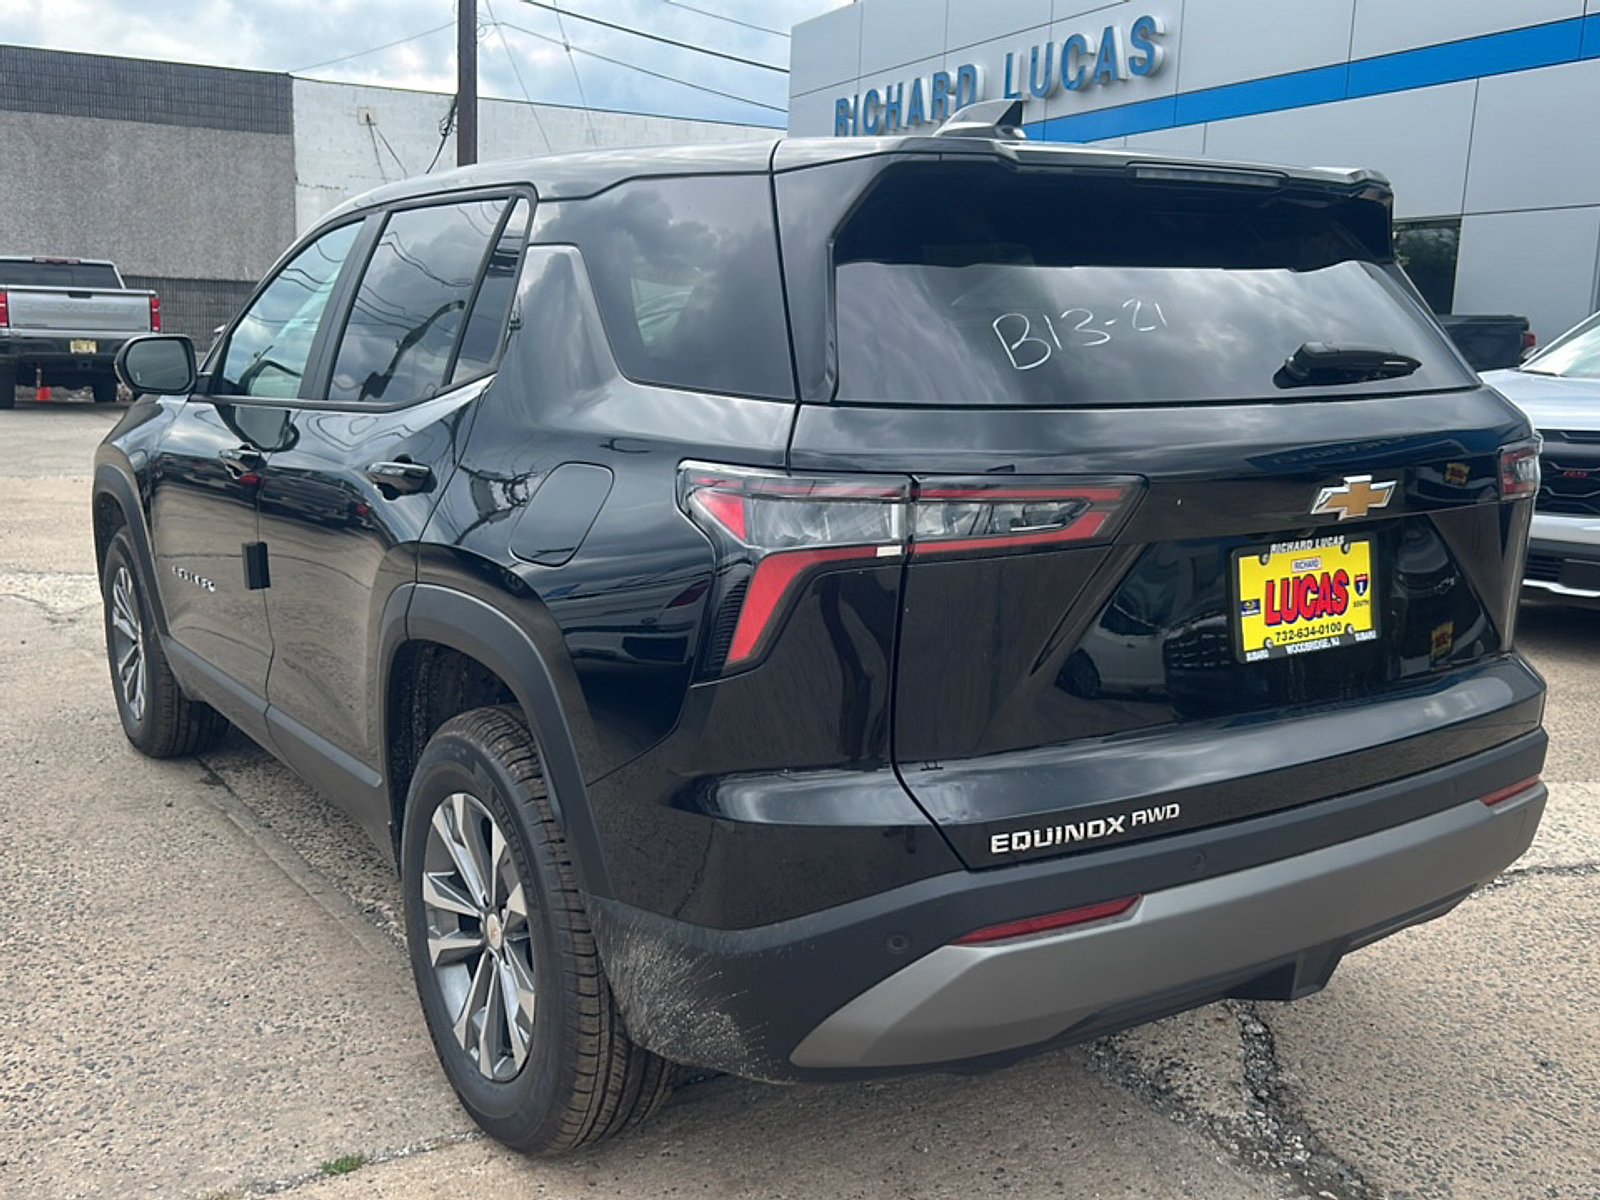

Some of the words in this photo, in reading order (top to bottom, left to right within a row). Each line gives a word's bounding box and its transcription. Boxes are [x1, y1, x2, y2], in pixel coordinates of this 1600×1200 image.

[835, 63, 984, 137] RICHARD
[1004, 15, 1165, 100] LUCAS
[992, 298, 1168, 369] B13-21
[1270, 539, 1314, 554] RICHARD
[1315, 535, 1345, 548] LUCAS
[1265, 569, 1349, 626] LUCAS
[1275, 621, 1342, 642] 732-634-0100
[991, 815, 1125, 853] EQUINOX
[1131, 802, 1180, 826] AWD
